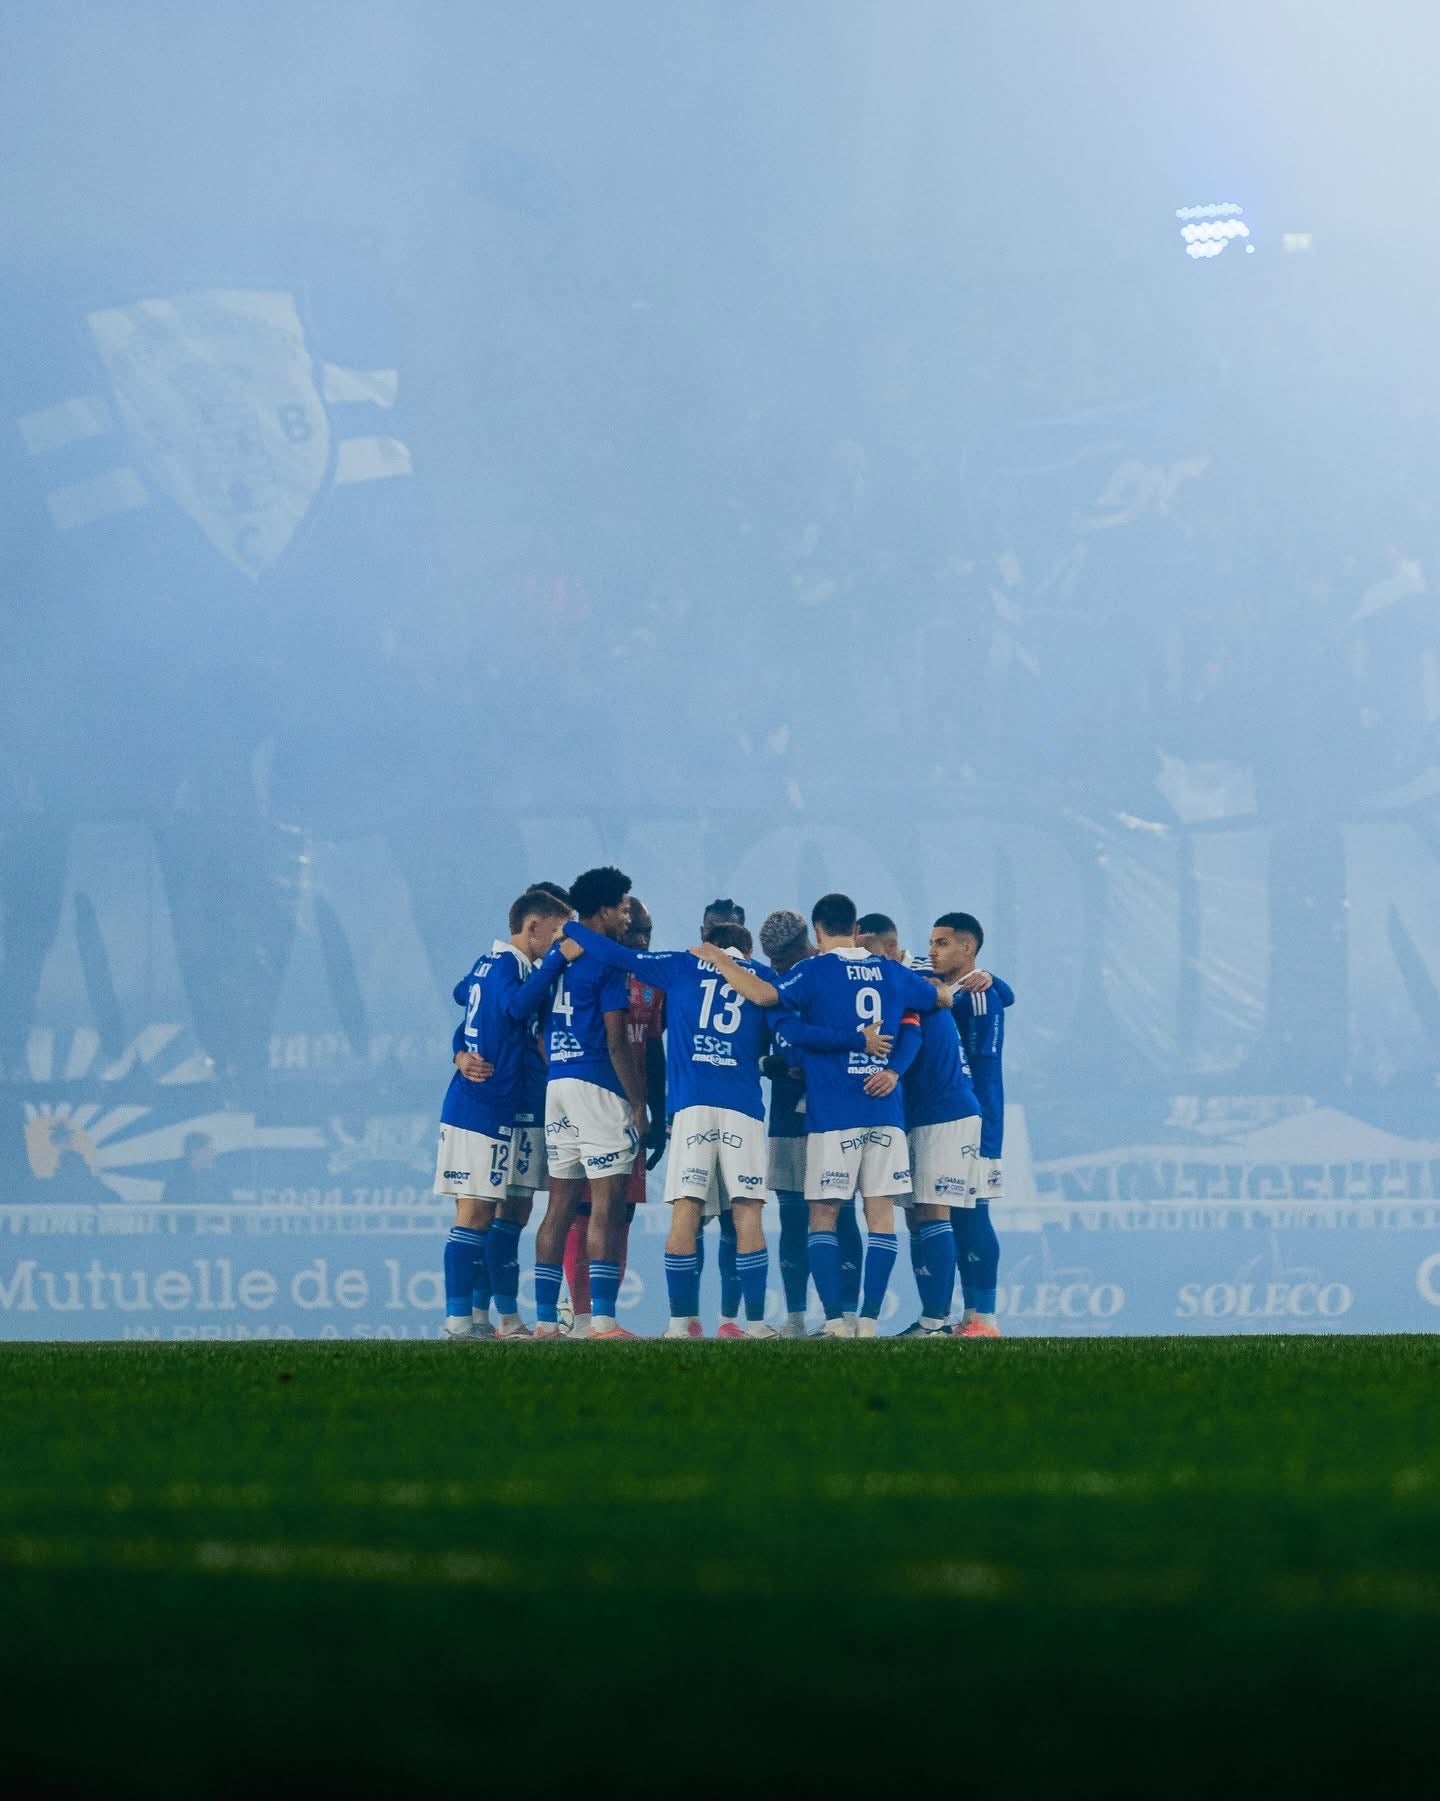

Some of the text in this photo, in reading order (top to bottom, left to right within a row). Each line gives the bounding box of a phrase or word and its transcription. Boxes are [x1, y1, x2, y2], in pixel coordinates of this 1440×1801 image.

[846, 965, 883, 981] F.TOMI
[699, 979, 745, 1034] 13
[856, 987, 881, 1035] 9
[490, 1144, 509, 1171] 12
[587, 1152, 620, 1167] GROOT
[0, 1259, 445, 1311] Mutuelle de la
